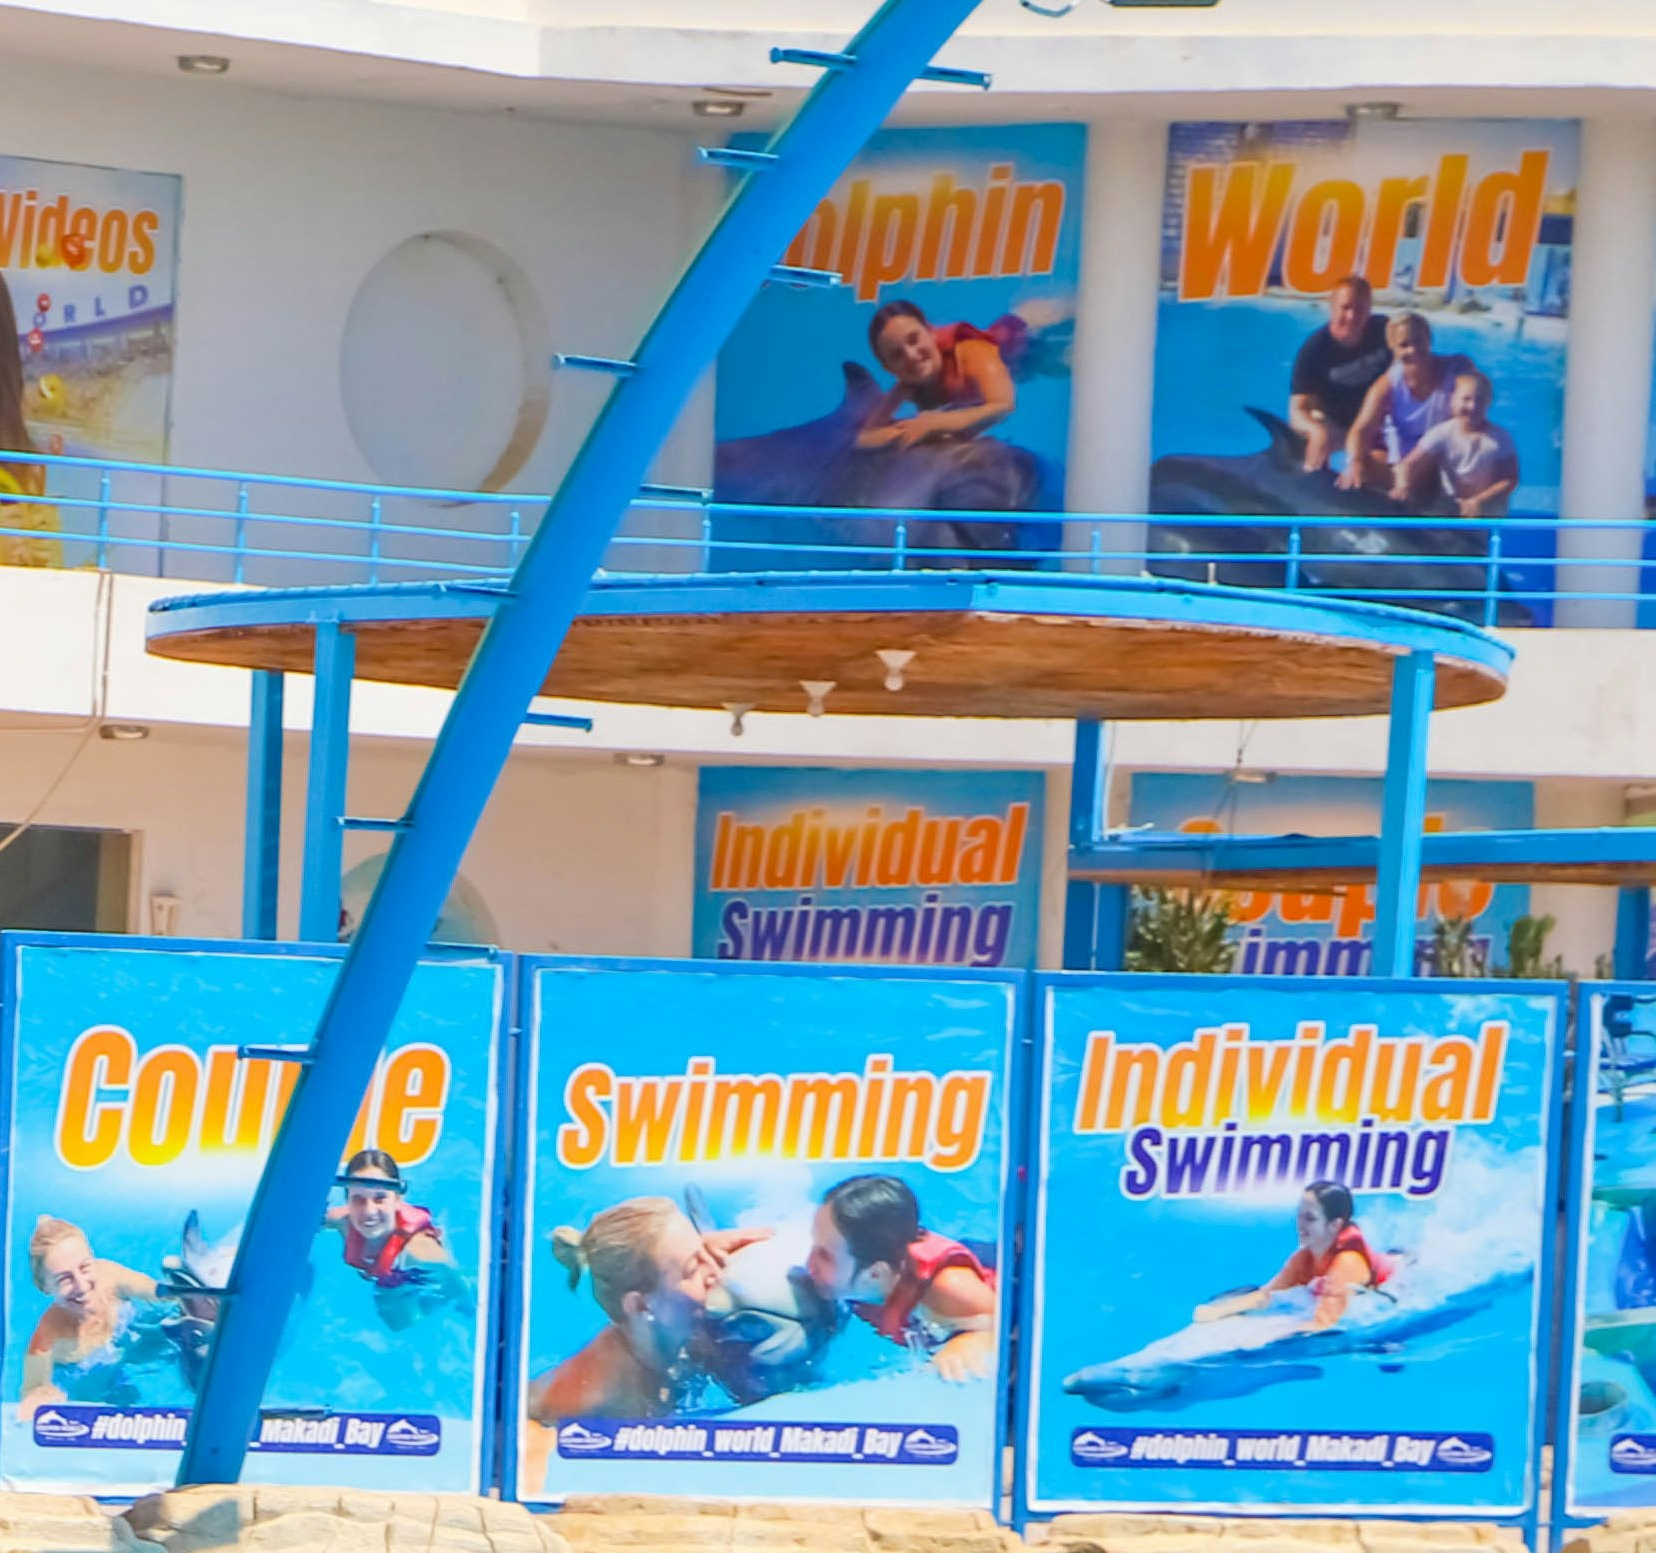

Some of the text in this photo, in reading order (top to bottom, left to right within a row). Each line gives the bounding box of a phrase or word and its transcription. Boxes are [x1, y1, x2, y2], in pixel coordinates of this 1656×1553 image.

[784, 164, 1064, 302] olphin
[1180, 149, 1549, 300] World
[32, 285, 149, 327] ORLD
[710, 803, 1030, 890] Individual
[717, 892, 1014, 967] Swimming
[58, 1029, 447, 1168] Coue
[561, 1059, 987, 1168] Swimming
[1076, 1025, 1508, 1131] Individual
[1125, 1118, 1451, 1196] Swimming
